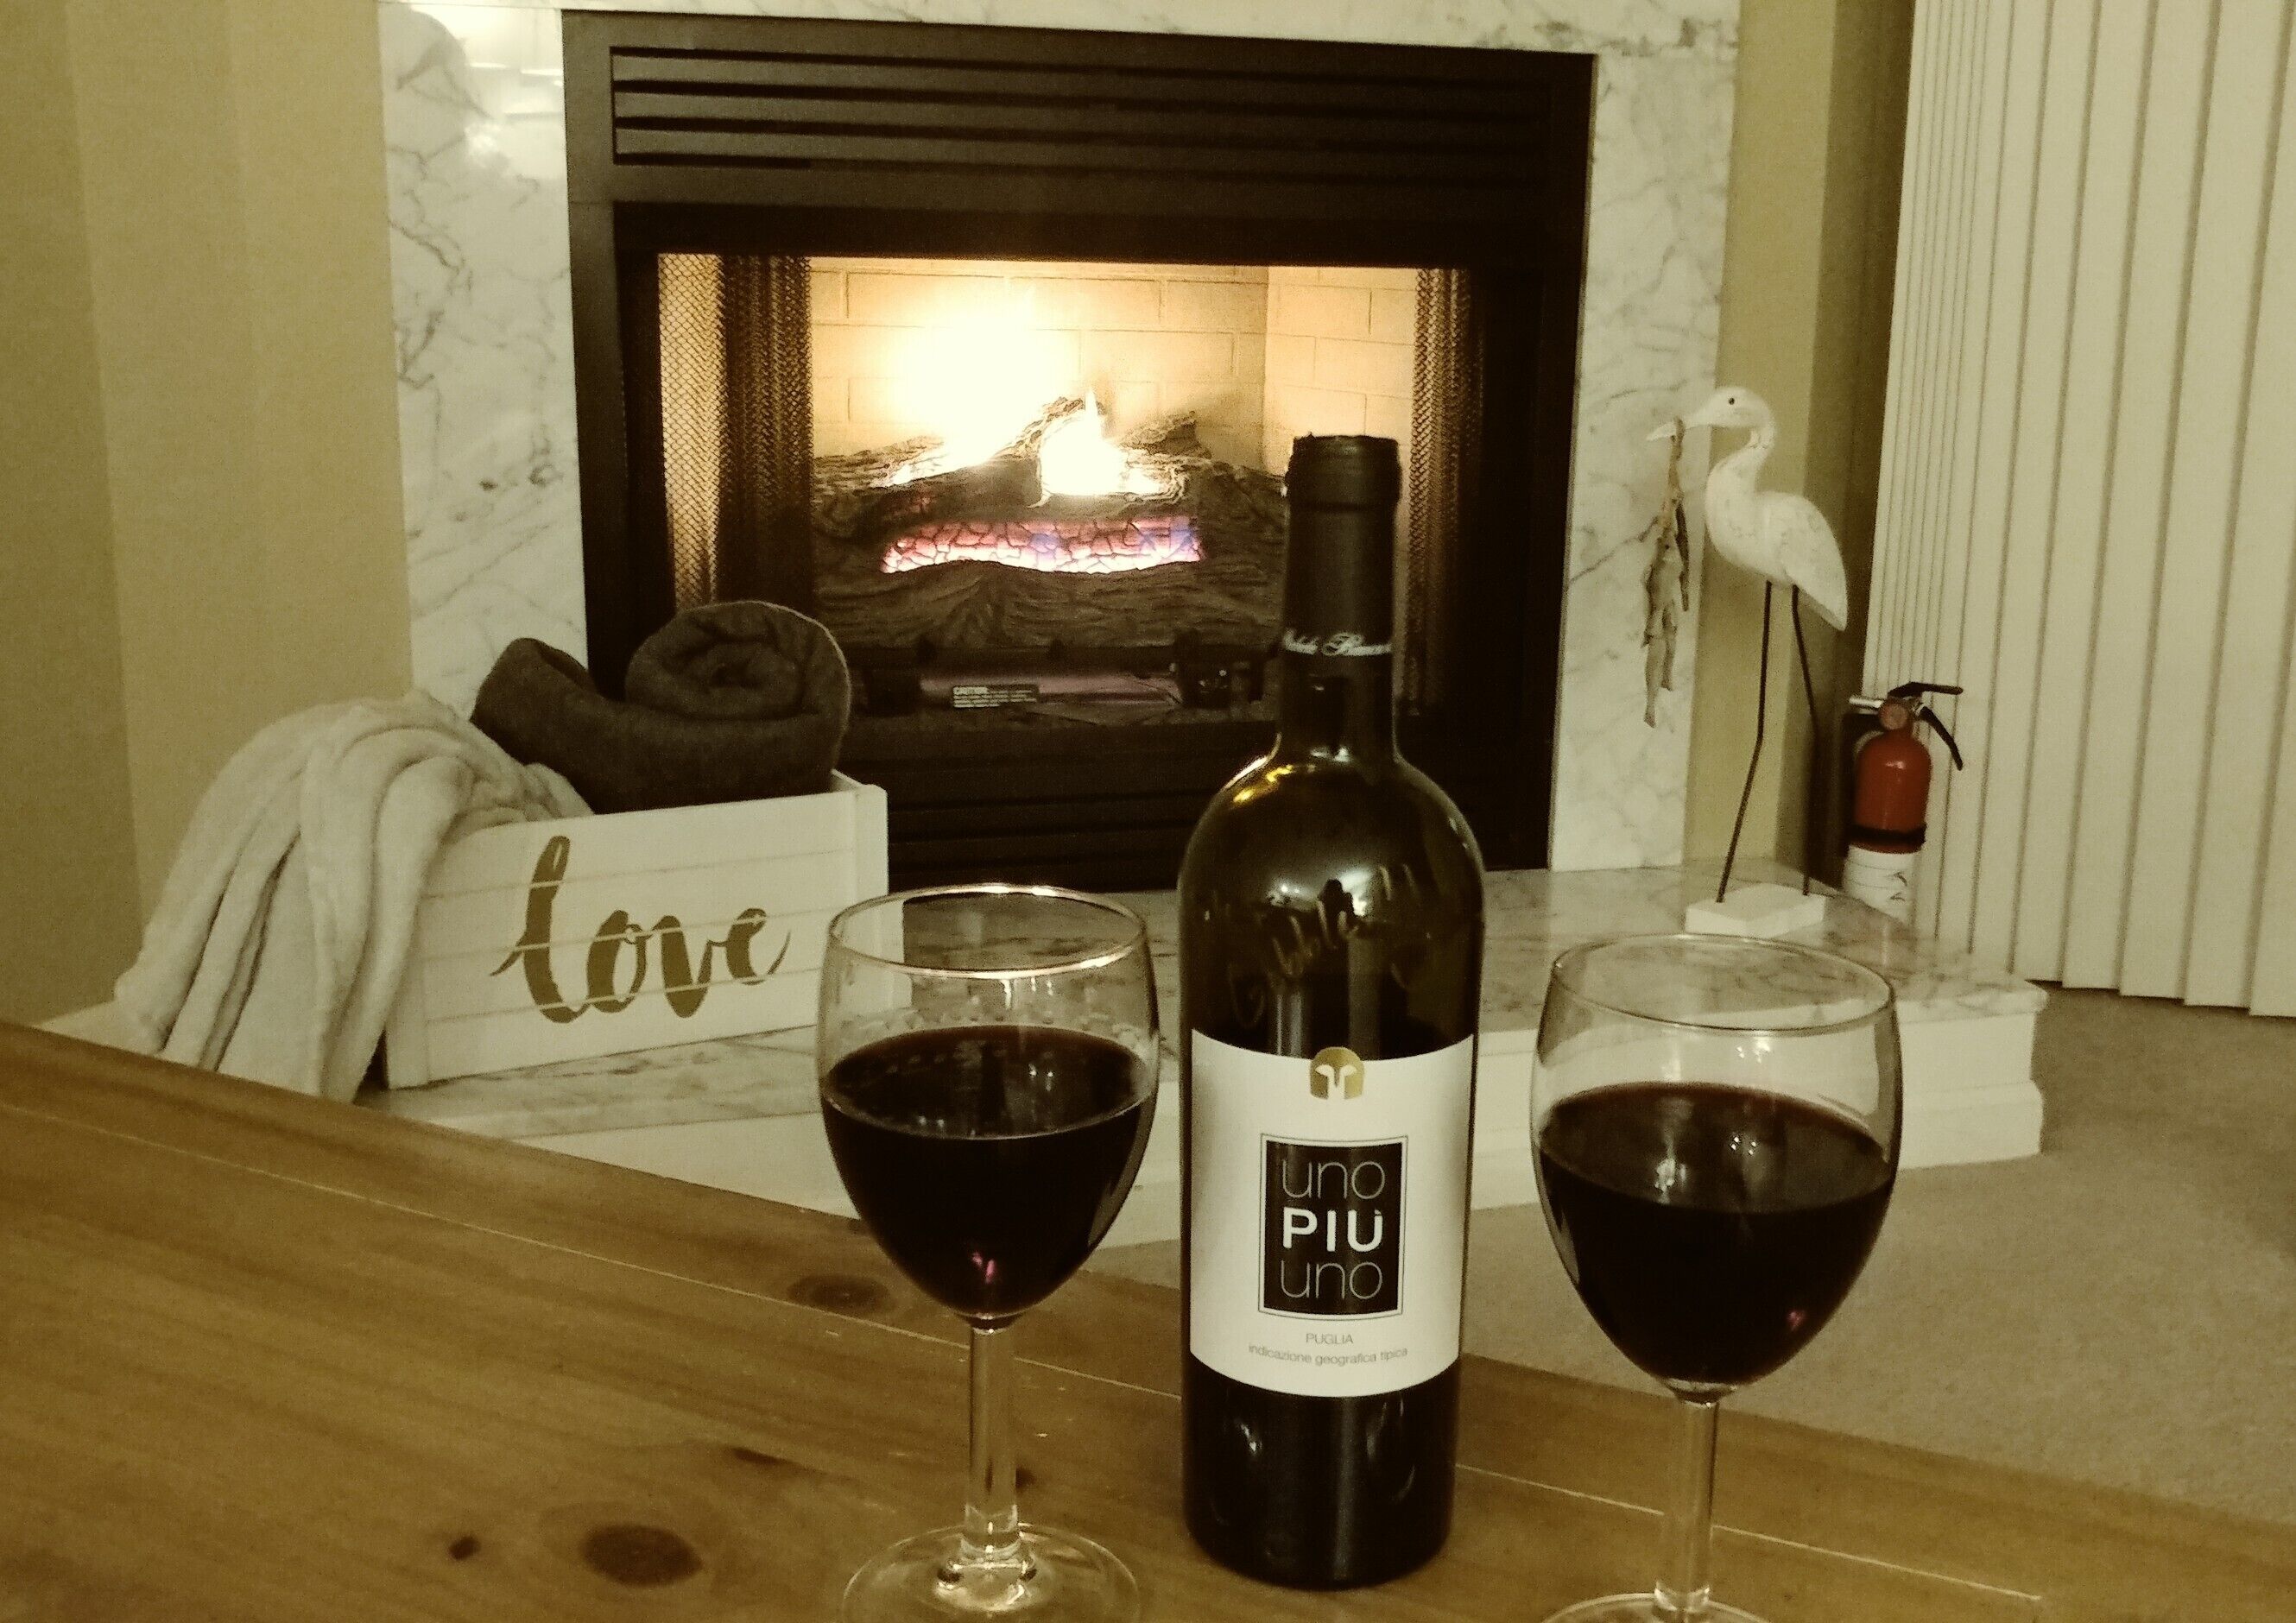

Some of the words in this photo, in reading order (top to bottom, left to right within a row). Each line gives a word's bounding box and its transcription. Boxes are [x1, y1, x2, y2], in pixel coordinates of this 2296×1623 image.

[490, 836, 791, 1024] love
[1282, 1160, 1386, 1200] uno
[1281, 1260, 1383, 1299] uno
[1249, 1344, 1312, 1363] indicazione
[1315, 1353, 1376, 1366] geografica
[1380, 1348, 1408, 1361] tipica
[1306, 1332, 1354, 1345] PUGLIA
